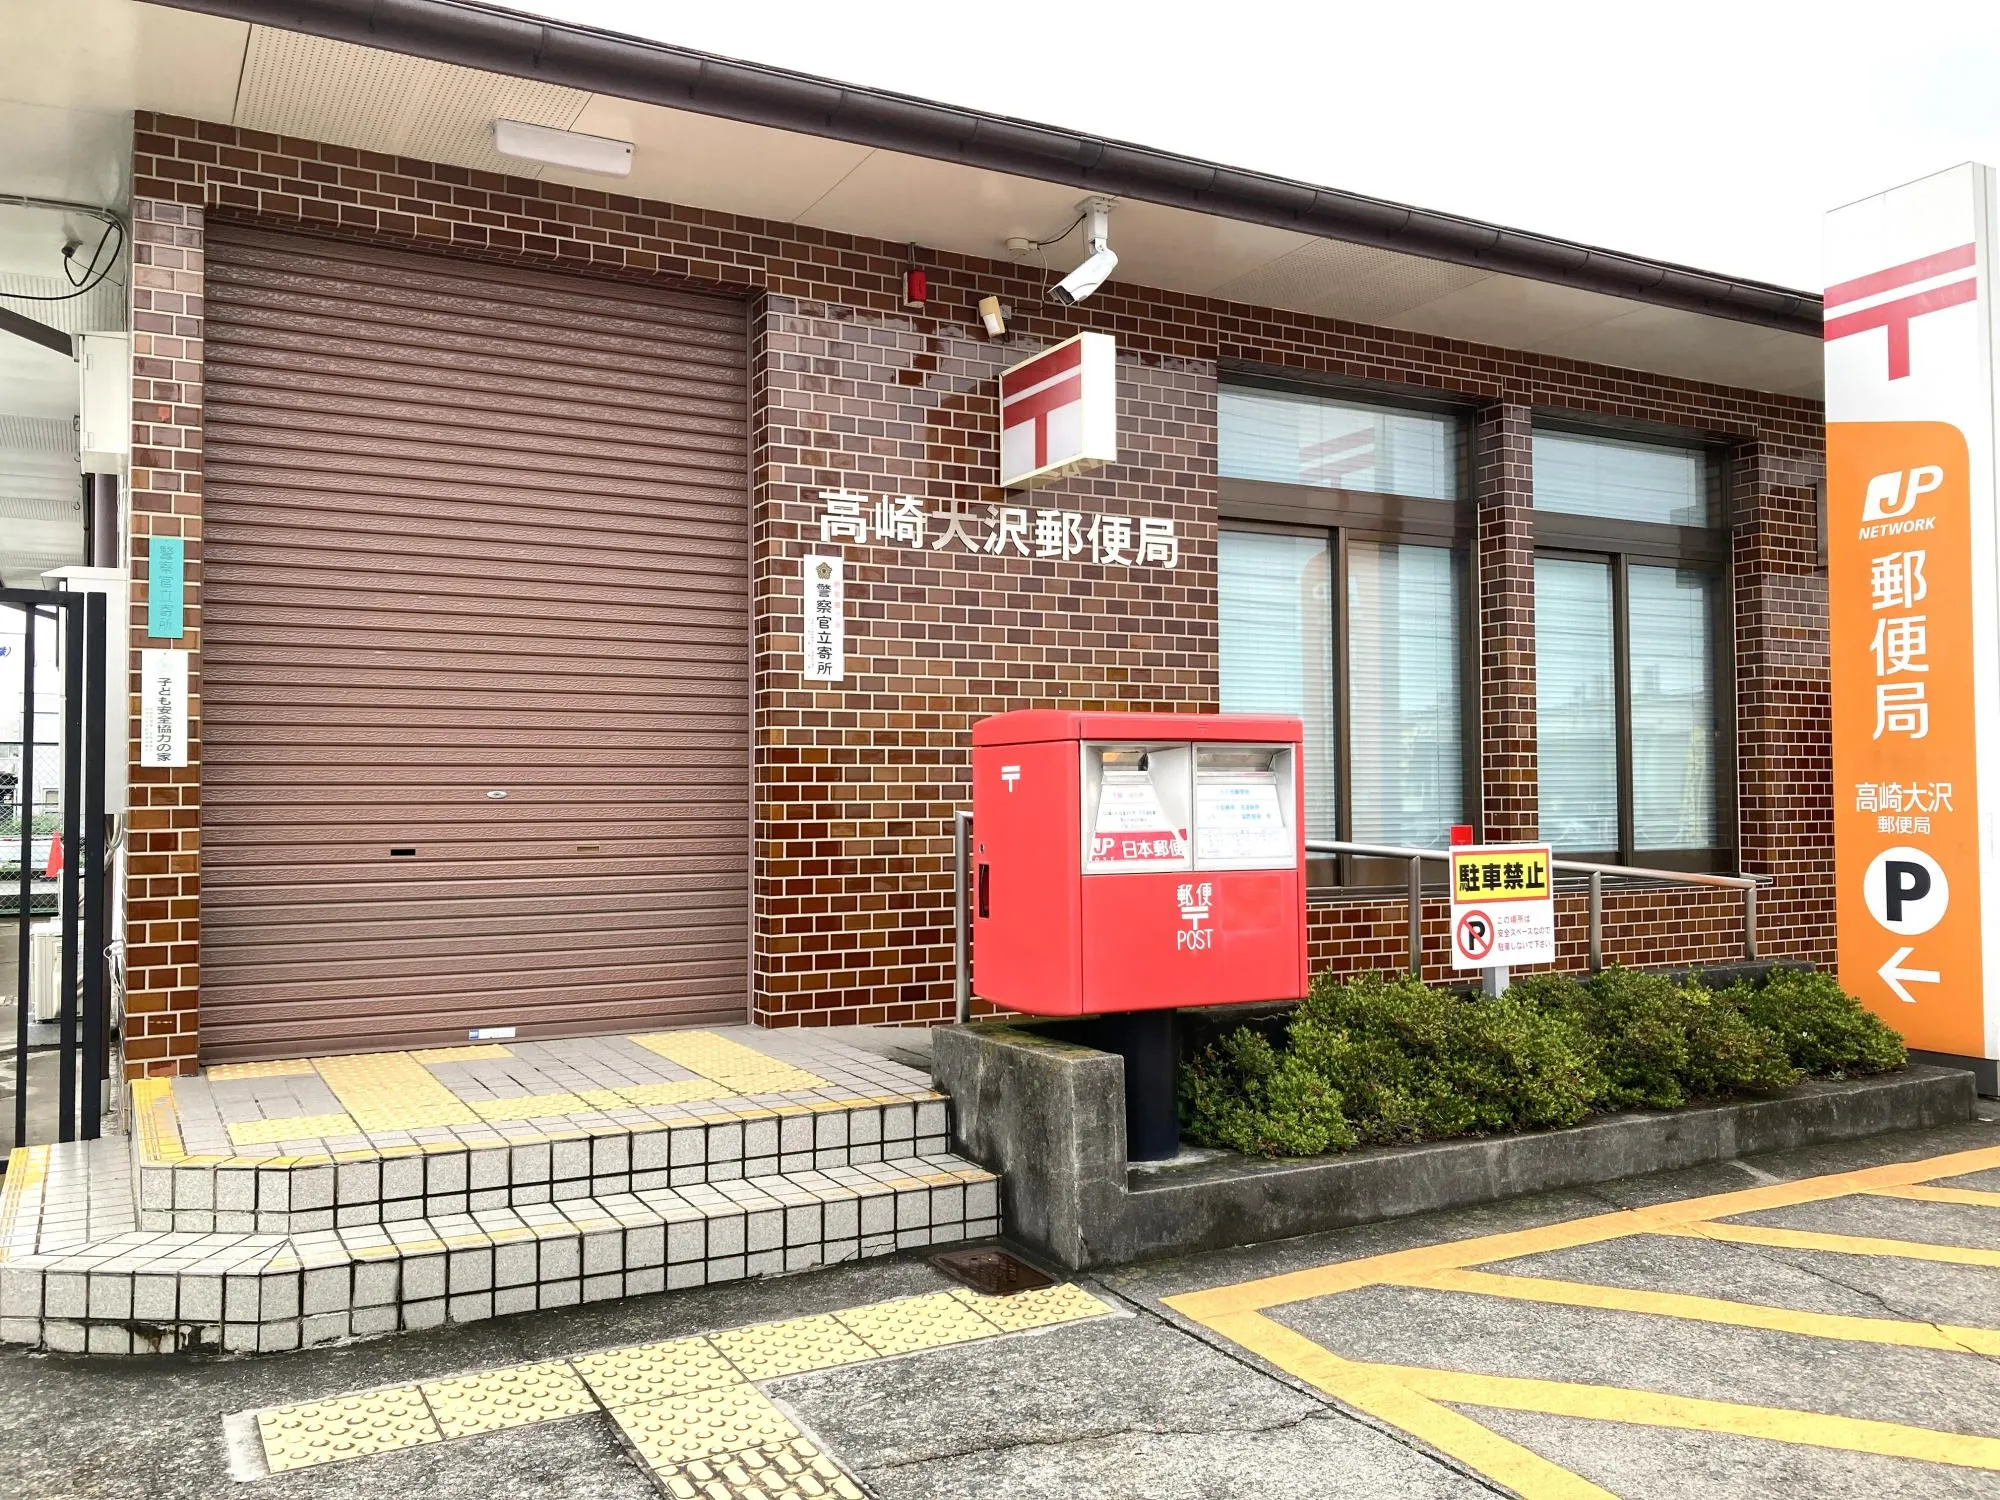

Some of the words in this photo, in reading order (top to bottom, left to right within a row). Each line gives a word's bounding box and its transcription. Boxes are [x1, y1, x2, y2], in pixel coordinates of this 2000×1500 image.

[1862, 465, 1944, 522] JP
[818, 487, 1179, 569] 高崎大沢郵便局
[1858, 516, 1936, 541] NETWORK
[159, 545, 174, 632] 警察官立寄所
[816, 583, 833, 676] 警察官立寄所
[1869, 549, 1930, 741] 郵便局
[156, 677, 173, 762] 子ども安全協力の家
[1854, 781, 1954, 813] 高崎大沢
[1877, 815, 1931, 835] 郵便局
[1176, 882, 1213, 908] 郵便
[1458, 861, 1545, 892] 駐車禁止
[1885, 860, 1931, 922] P
[1177, 928, 1214, 951] POST
